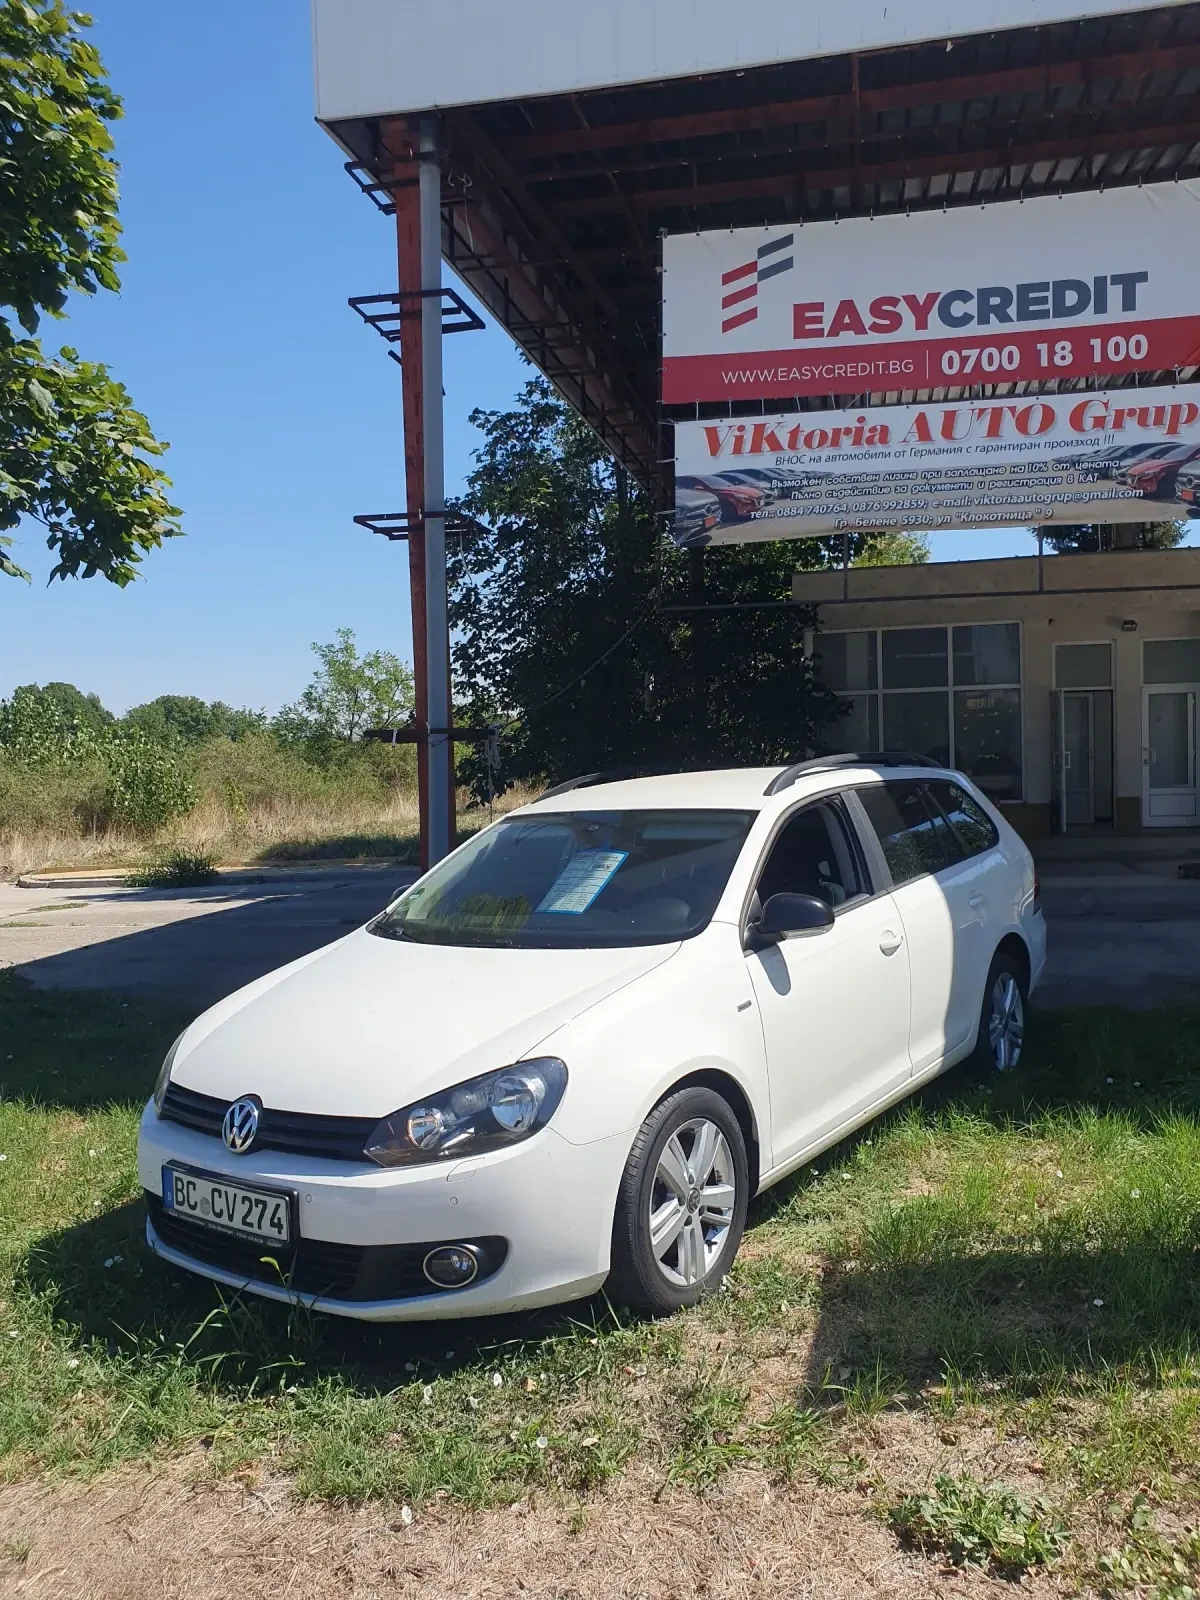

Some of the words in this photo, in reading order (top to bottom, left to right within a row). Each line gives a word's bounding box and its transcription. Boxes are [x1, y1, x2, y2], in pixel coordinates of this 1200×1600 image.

[793, 270, 1149, 340] EASYCREDIT
[941, 345, 1020, 375] 0700
[1036, 340, 1073, 367] 18
[1089, 333, 1148, 363] 100
[721, 359, 914, 384] WWW.EASYCREDIT.BG
[701, 415, 892, 457] ViKtoria
[898, 403, 1056, 443] AUTO
[1068, 398, 1199, 436] Grup
[775, 454, 806, 466] ВНОС
[808, 455, 822, 464] на
[824, 451, 891, 463] автомобили
[894, 449, 908, 458] от
[910, 446, 963, 459] Германия
[965, 446, 972, 454] с
[974, 441, 1041, 455] гарантиран
[1043, 437, 1100, 450] произход
[1103, 434, 1115, 445] !!!
[771, 475, 823, 489] Възможен
[826, 473, 879, 486] собствен
[882, 471, 918, 482] лизинг
[921, 470, 942, 481] при
[944, 465, 1006, 477] заплащане
[1011, 465, 1024, 474] на
[1027, 462, 1048, 473] 10%
[1052, 461, 1070, 471] от
[1075, 458, 1119, 471] цената
[790, 490, 821, 501] Пълно
[825, 485, 891, 499] съдействие
[894, 484, 908, 494] за
[911, 480, 973, 495] документи
[977, 480, 985, 489] и
[988, 475, 1062, 491] регистрация
[1078, 473, 1099, 484] КАТ
[776, 505, 804, 517] 0884
[852, 501, 880, 513] 0876
[973, 487, 1144, 506] viktoriaautogrup@gmail.com
[855, 515, 897, 527] Белене
[900, 513, 933, 526] 5930;
[937, 513, 951, 527] ул
[174, 1175, 198, 1211] BC
